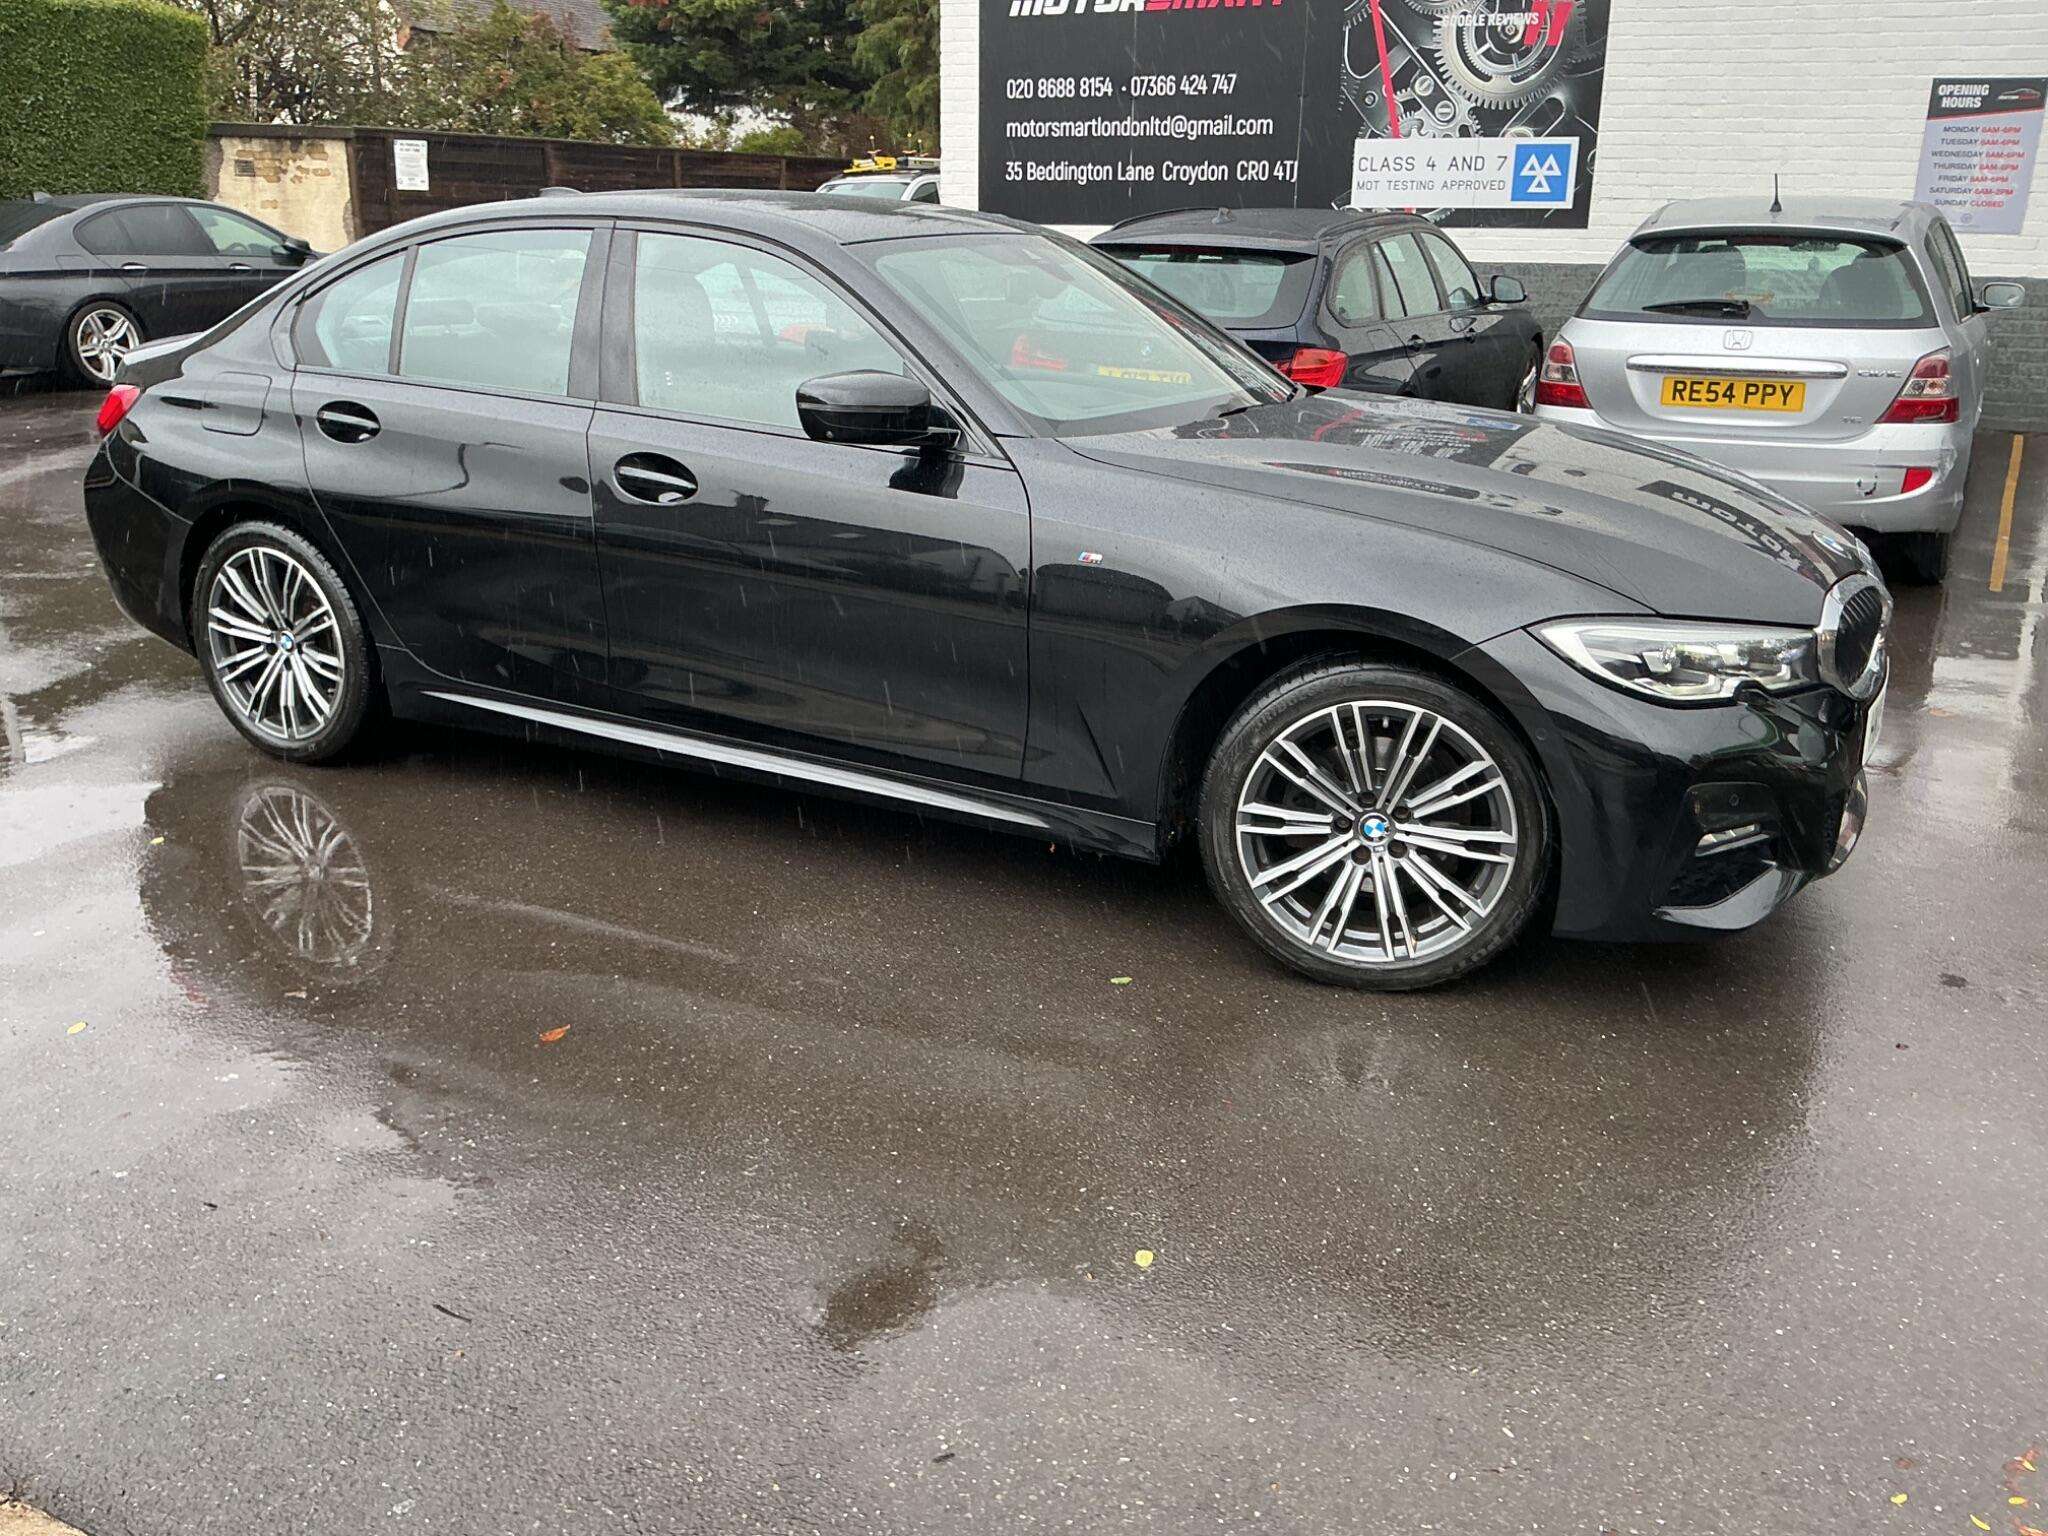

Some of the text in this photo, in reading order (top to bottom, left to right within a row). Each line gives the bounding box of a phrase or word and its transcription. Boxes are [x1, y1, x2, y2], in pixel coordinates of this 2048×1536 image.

[1488, 12, 1540, 26] REVIEWS
[1006, 73, 1238, 99] 020 8688 8154 07366 424 747
[1938, 84, 1990, 96] OPENING
[1941, 97, 1982, 108] HOURS
[1006, 114, 1274, 141] motorsmartlondonltd@gmail.com
[1940, 138, 1979, 146] TUESDAY
[1931, 150, 1983, 158] WEDNESDAY
[1358, 155, 1508, 173] CLASS 4 AND 7
[1933, 162, 1978, 170] THURSDAY
[1005, 161, 1023, 182] 35
[1026, 160, 1113, 186] Beddington
[1117, 161, 1155, 182] Lane
[1162, 160, 1229, 186] Croydon
[1273, 160, 1299, 183] 4TJ
[1356, 179, 1507, 191] MOT TESTING APPROVED
[1970, 200, 2005, 208] CLOSED
[1671, 380, 1796, 407] RE54 PPY
